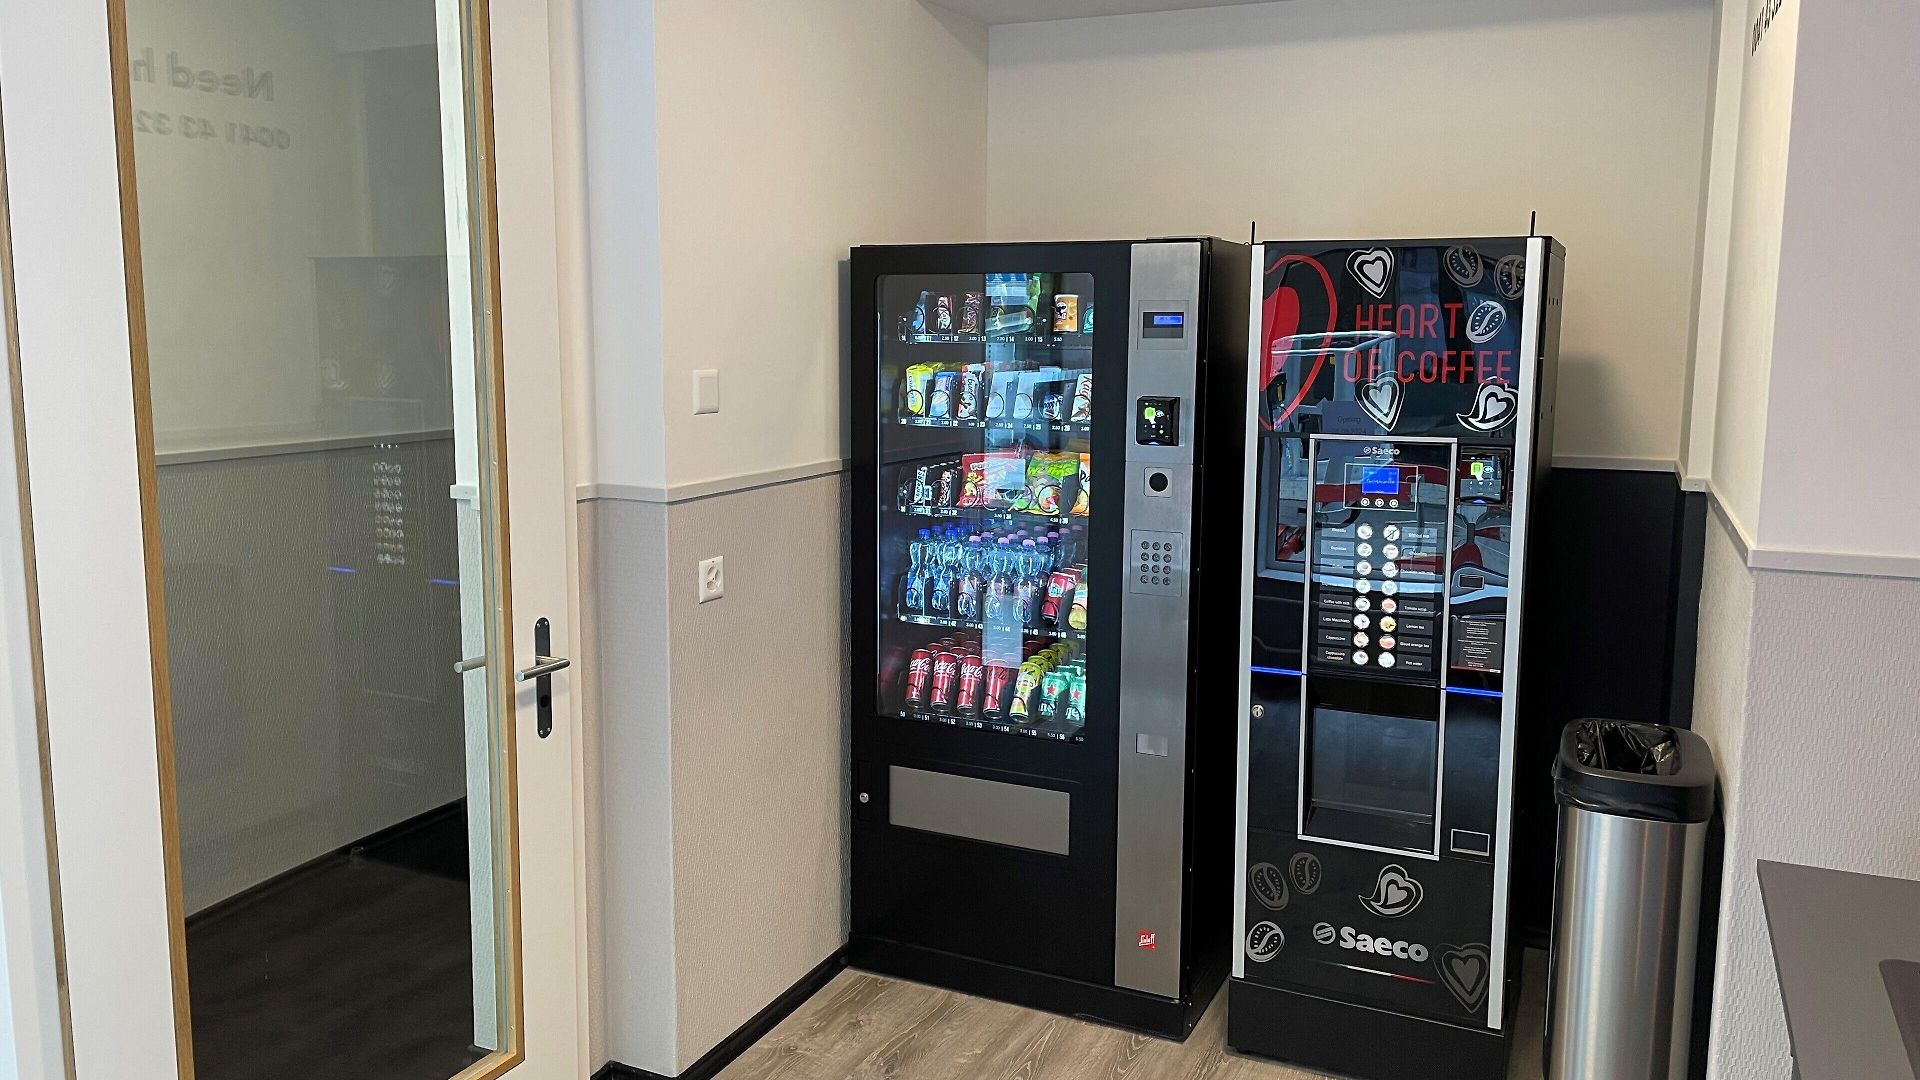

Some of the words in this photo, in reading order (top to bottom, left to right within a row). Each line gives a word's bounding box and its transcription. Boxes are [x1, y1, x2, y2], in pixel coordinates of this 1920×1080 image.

[1356, 303, 1463, 339] HEART
[1343, 349, 1382, 383] OF
[1397, 350, 1512, 385] COFFEE
[1372, 447, 1400, 455] Saeco
[1339, 926, 1429, 962] Saeco
